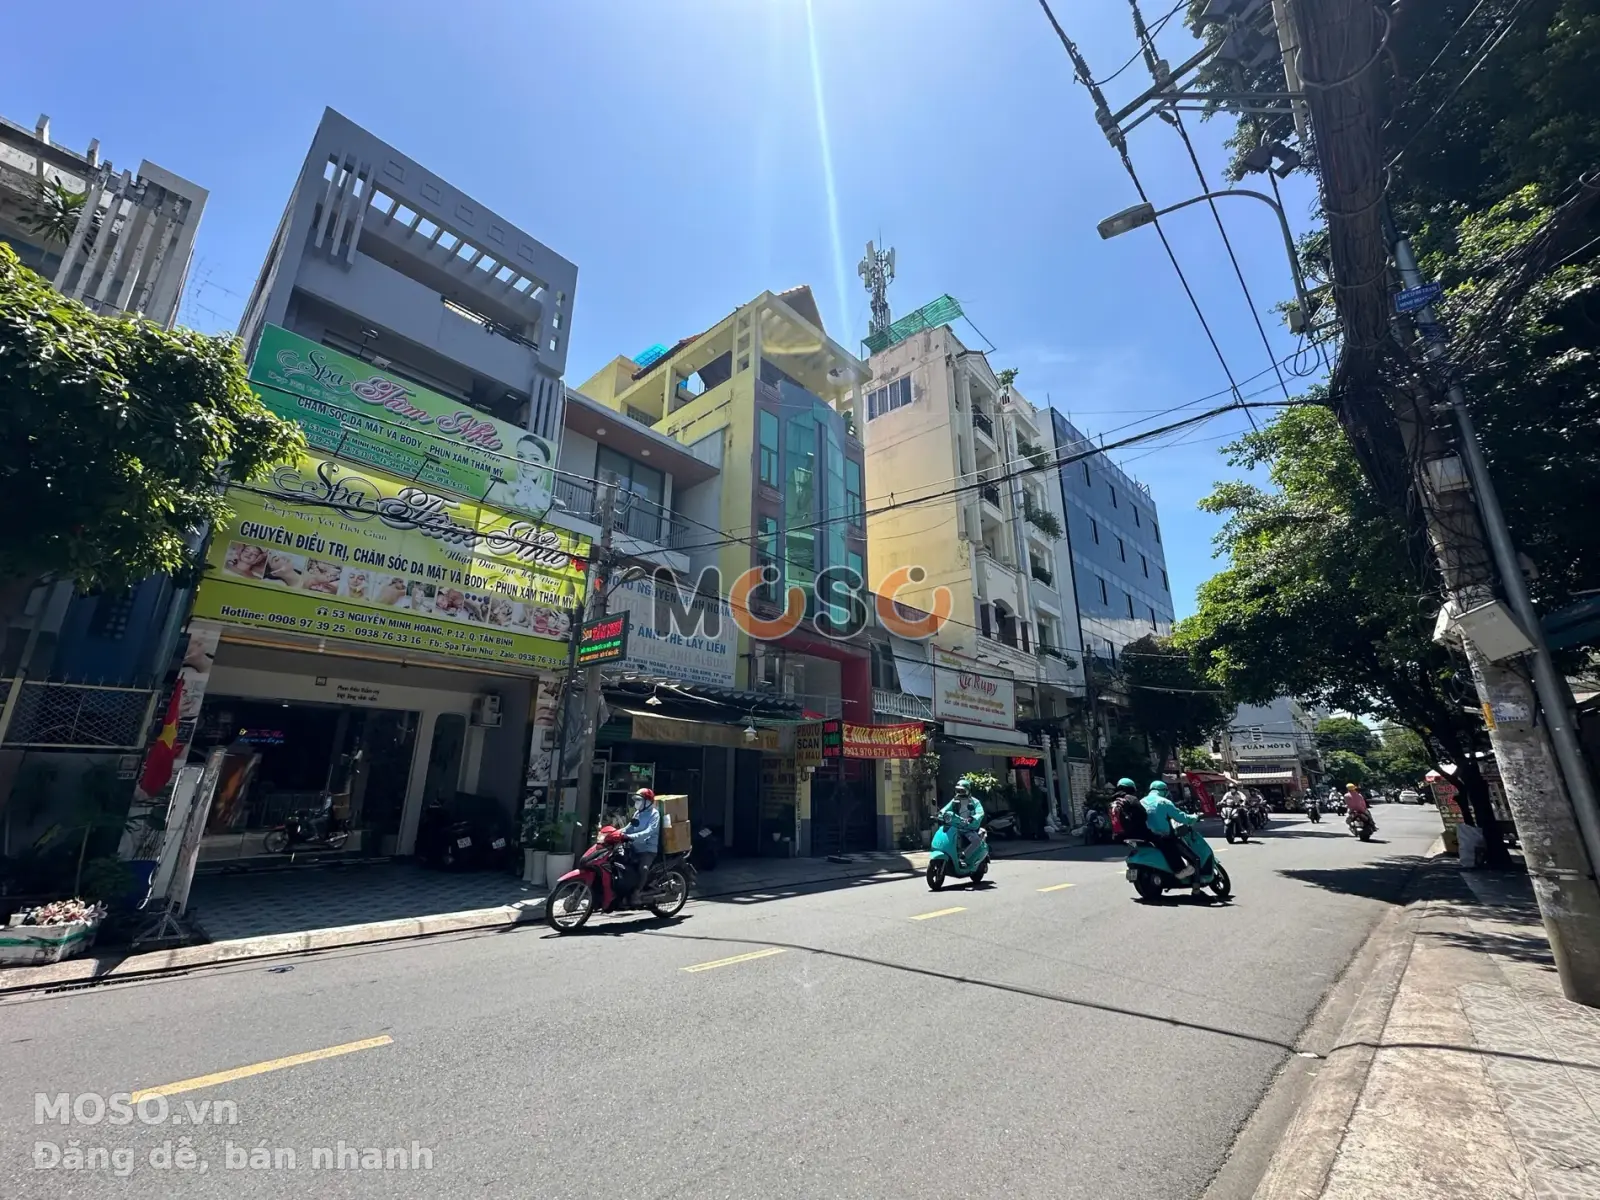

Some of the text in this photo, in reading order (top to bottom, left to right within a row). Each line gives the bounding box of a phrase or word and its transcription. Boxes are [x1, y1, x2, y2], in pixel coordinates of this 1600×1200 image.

[350, 415, 362, 428] DA
[400, 432, 423, 449] BODY
[429, 444, 451, 460] PHUN
[352, 438, 369, 450] MINH
[240, 521, 294, 546] CHUYÊN
[295, 530, 325, 554] ĐIỀU
[329, 541, 349, 562] TRỊ,
[353, 547, 385, 568] CHĂM
[387, 553, 409, 572] SÓC
[411, 560, 424, 576] DA
[426, 564, 446, 583] MẶT
[450, 569, 462, 585] VÀ
[464, 574, 489, 590] BODY
[495, 580, 518, 597] PHUN
[221, 605, 265, 621] Hotline:
[268, 613, 296, 626] 0908
[300, 619, 313, 628] 97
[316, 621, 330, 631] 39
[332, 623, 345, 633] 25
[355, 627, 379, 638] 0938
[382, 631, 394, 641] 76
[396, 634, 408, 643] 33
[410, 635, 421, 644] 16
[444, 642, 459, 652] Spa
[499, 650, 516, 660] Zalo:
[518, 652, 535, 662] 0938
[537, 655, 546, 663] 76
[548, 657, 556, 665] 33
[558, 658, 567, 667] 16
[332, 609, 345, 619] 53
[388, 619, 411, 630] MINH
[468, 632, 477, 642] Q.
[479, 633, 495, 644] TÂN
[796, 738, 819, 750] SCAN
